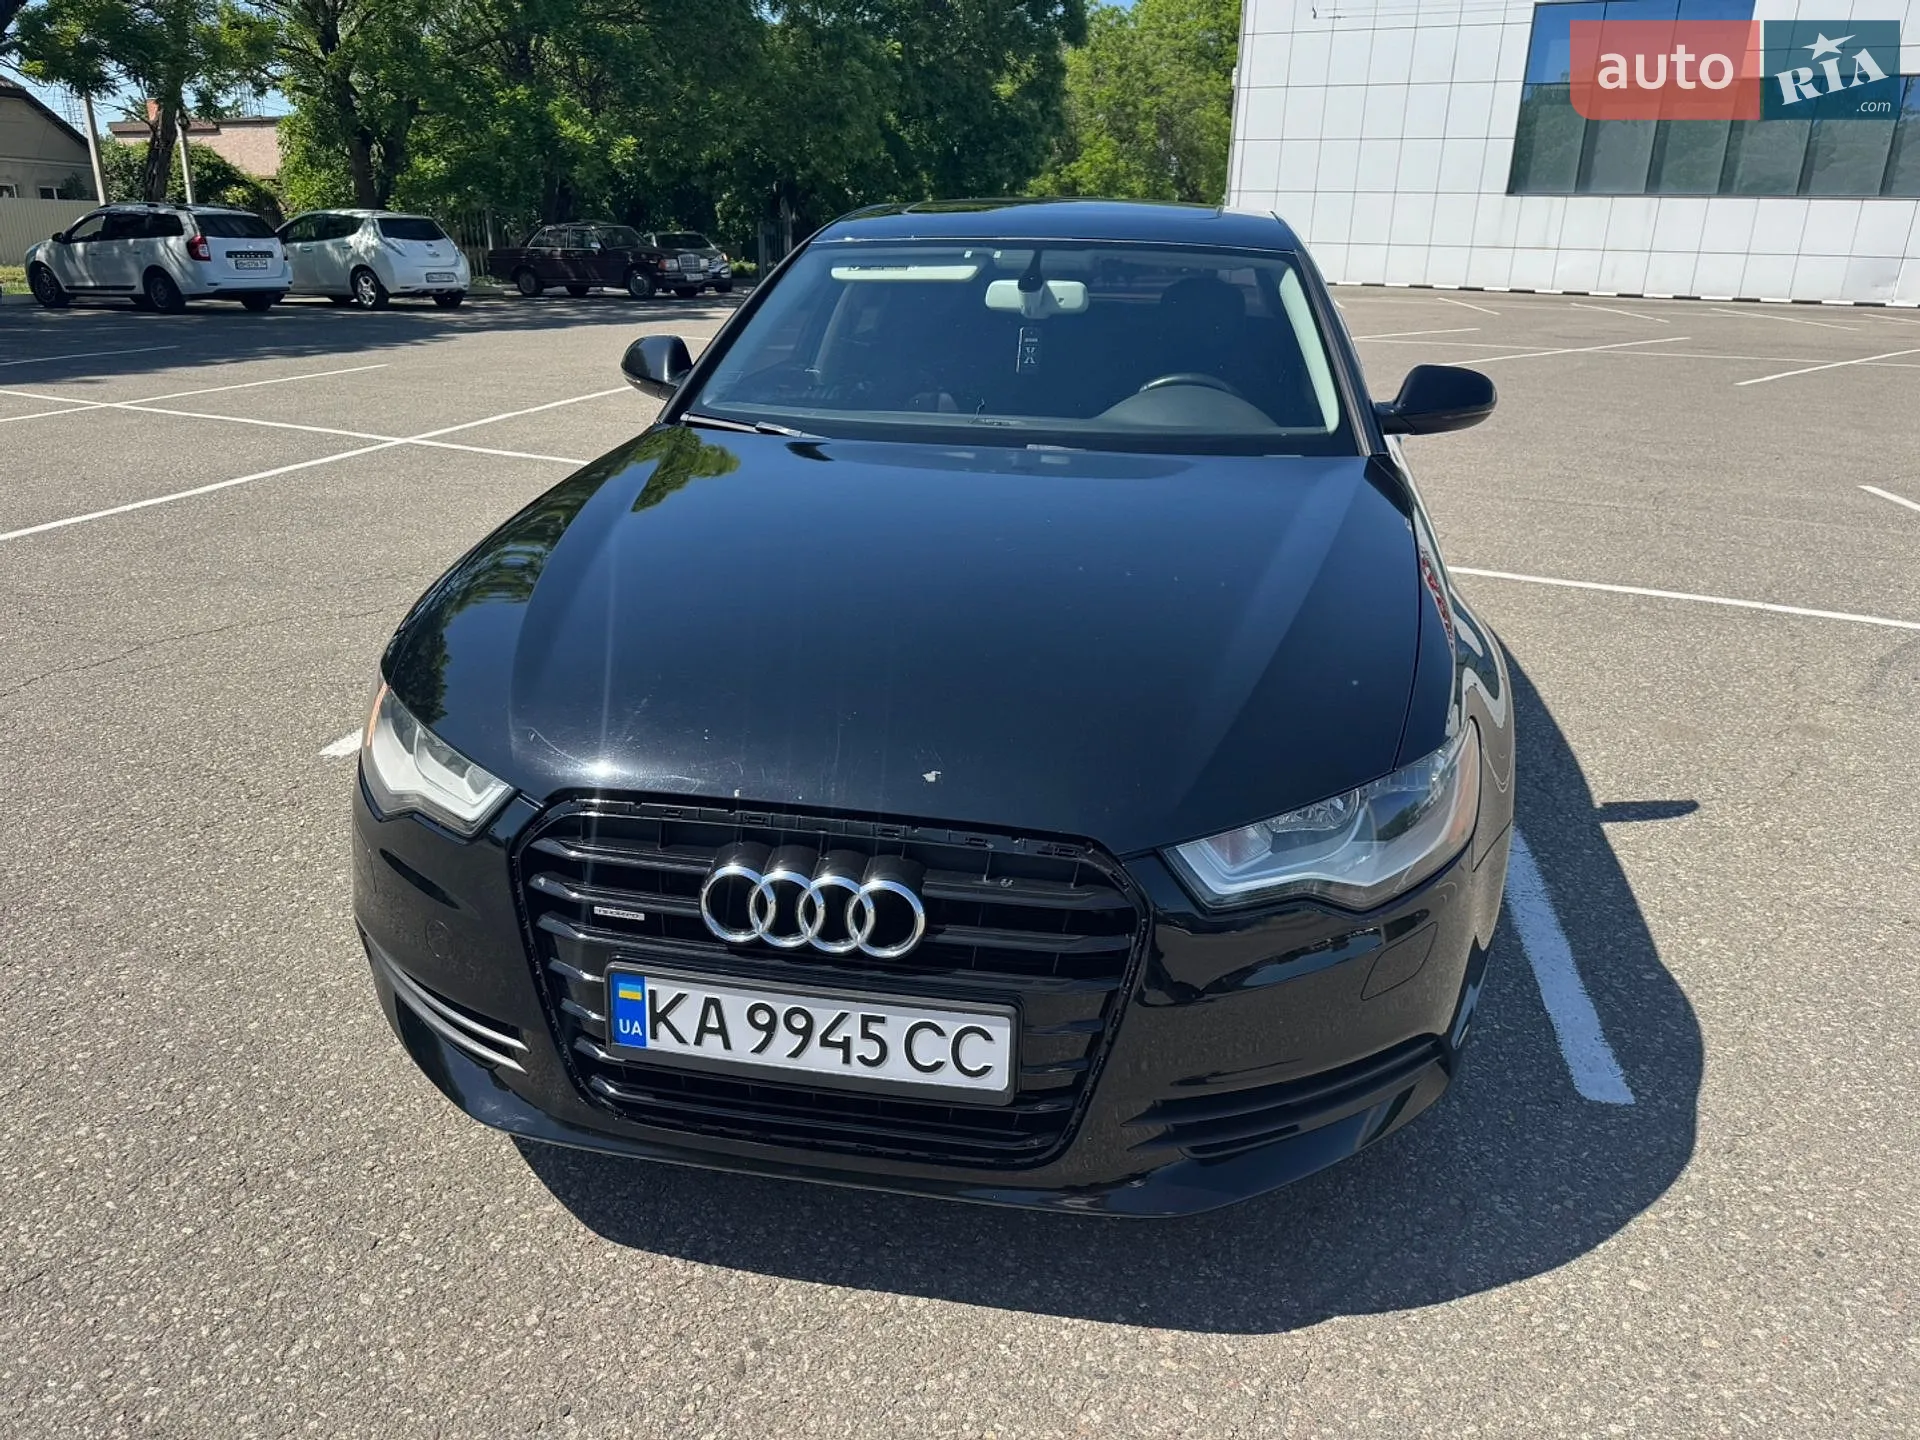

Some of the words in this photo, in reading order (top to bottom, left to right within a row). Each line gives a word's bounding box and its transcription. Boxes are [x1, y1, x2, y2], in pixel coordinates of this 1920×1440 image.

[618, 1020, 643, 1036] UA
[648, 989, 733, 1051] KA
[746, 1002, 889, 1067] 9945
[903, 1021, 994, 1078] CC
